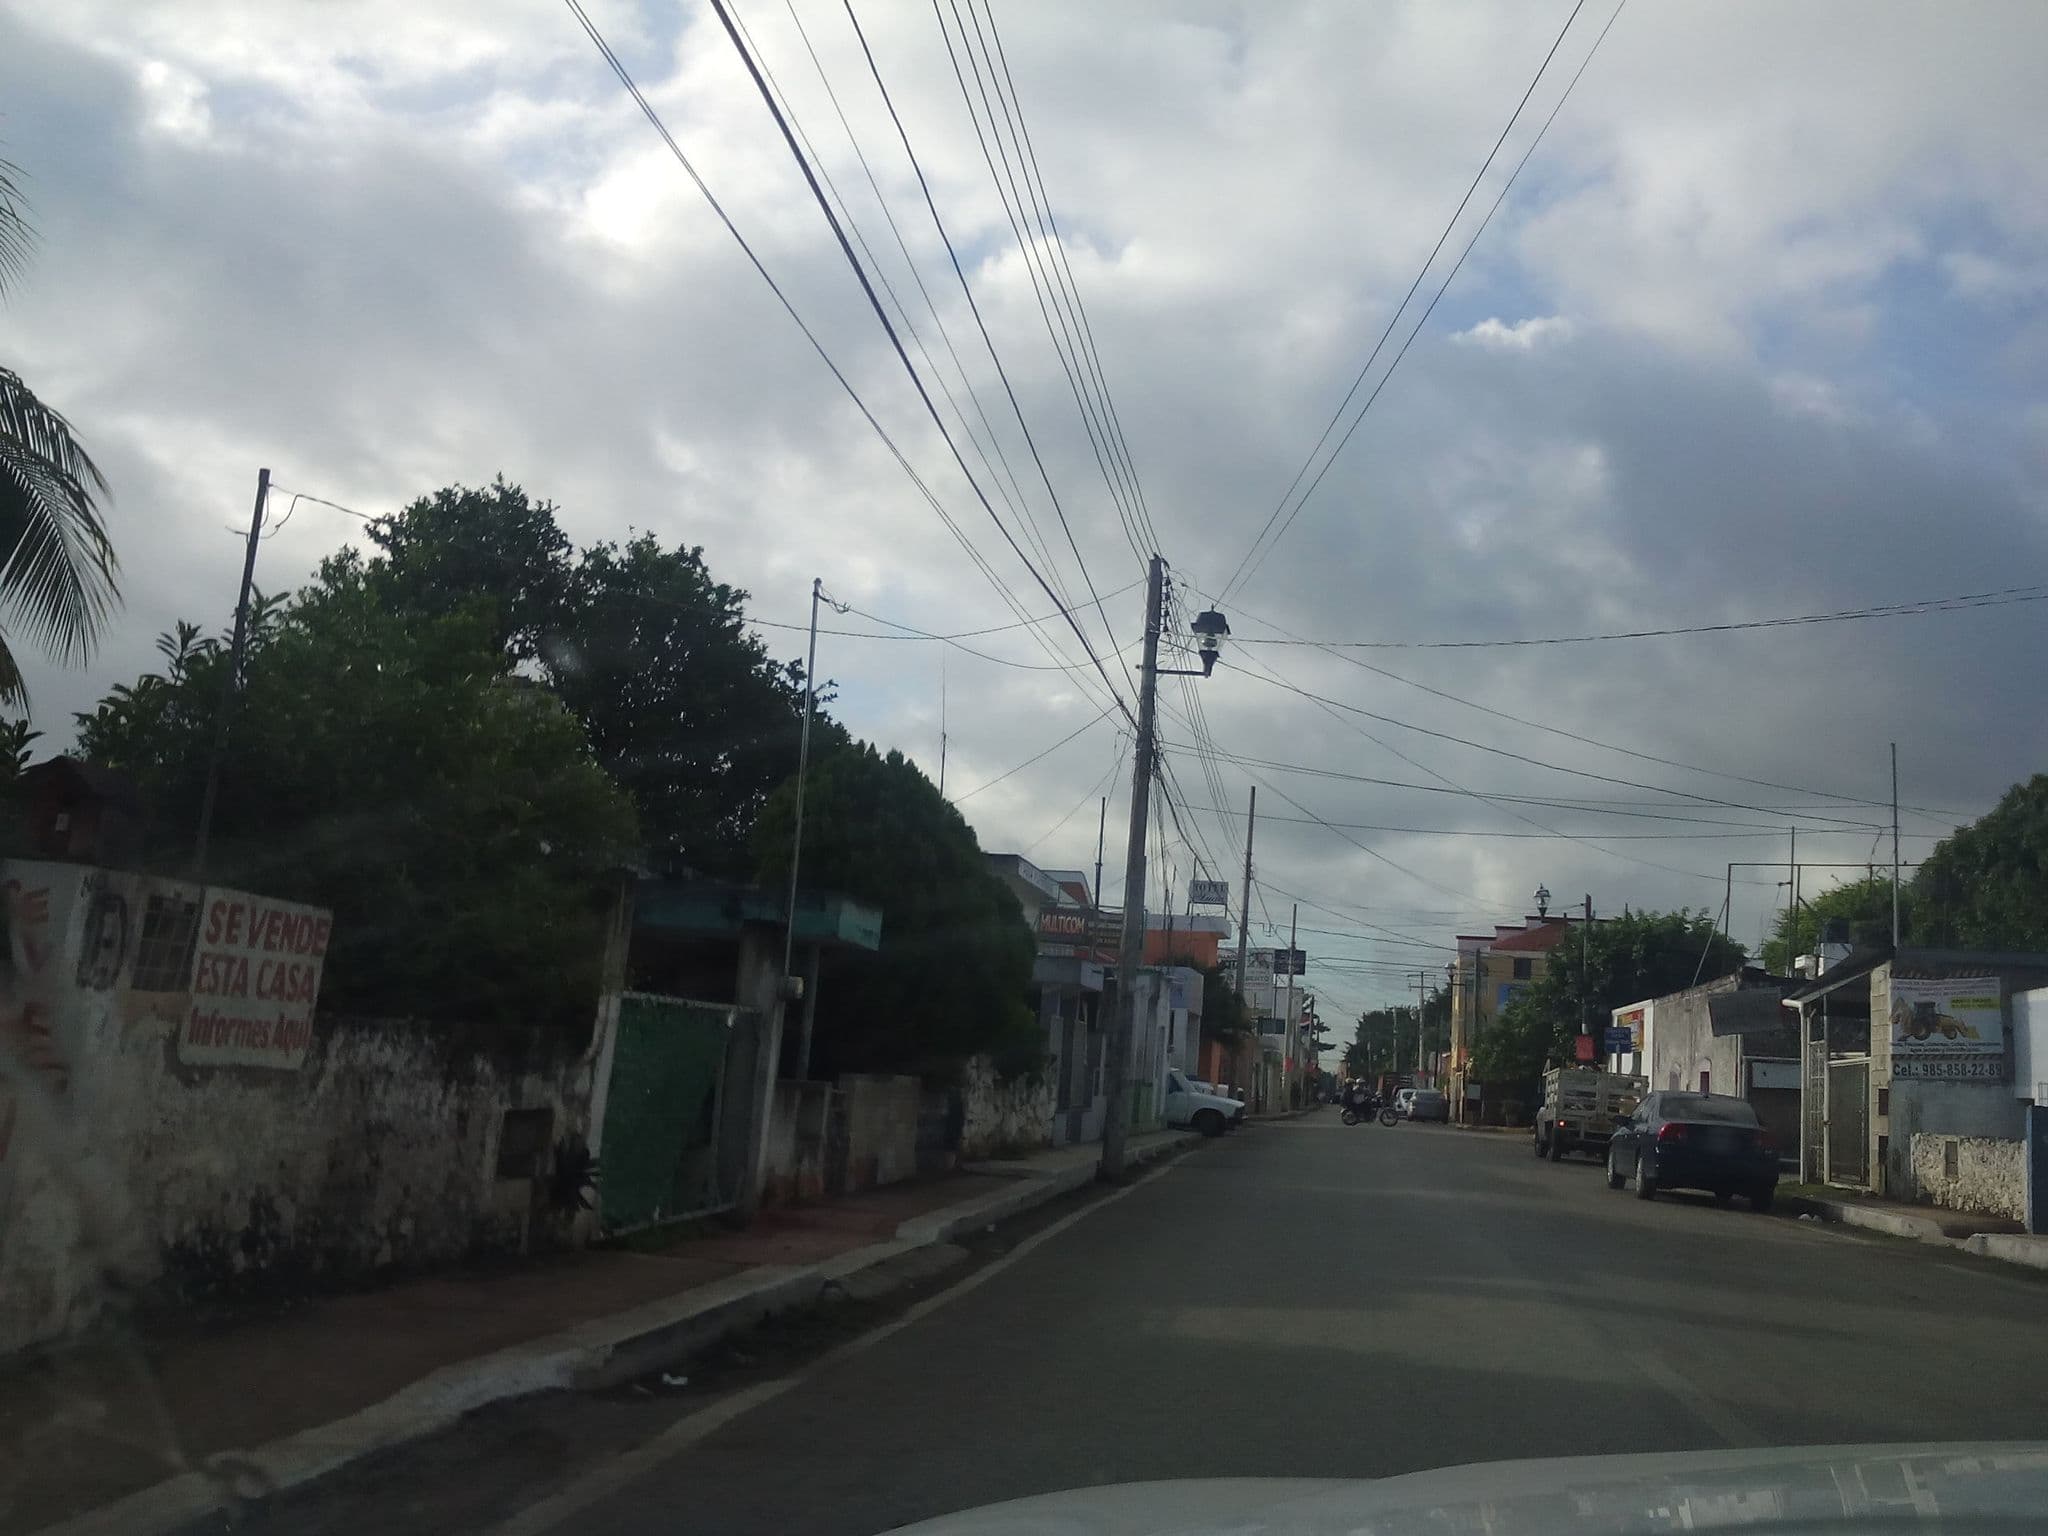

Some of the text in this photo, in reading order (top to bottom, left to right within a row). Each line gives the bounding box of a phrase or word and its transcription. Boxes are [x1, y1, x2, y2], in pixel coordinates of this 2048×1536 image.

[206, 900, 332, 955] SE VENDE
[1040, 914, 1085, 934] MULTICOM
[196, 951, 315, 1003] ESTA CASA
[189, 1007, 272, 1050] Informes
